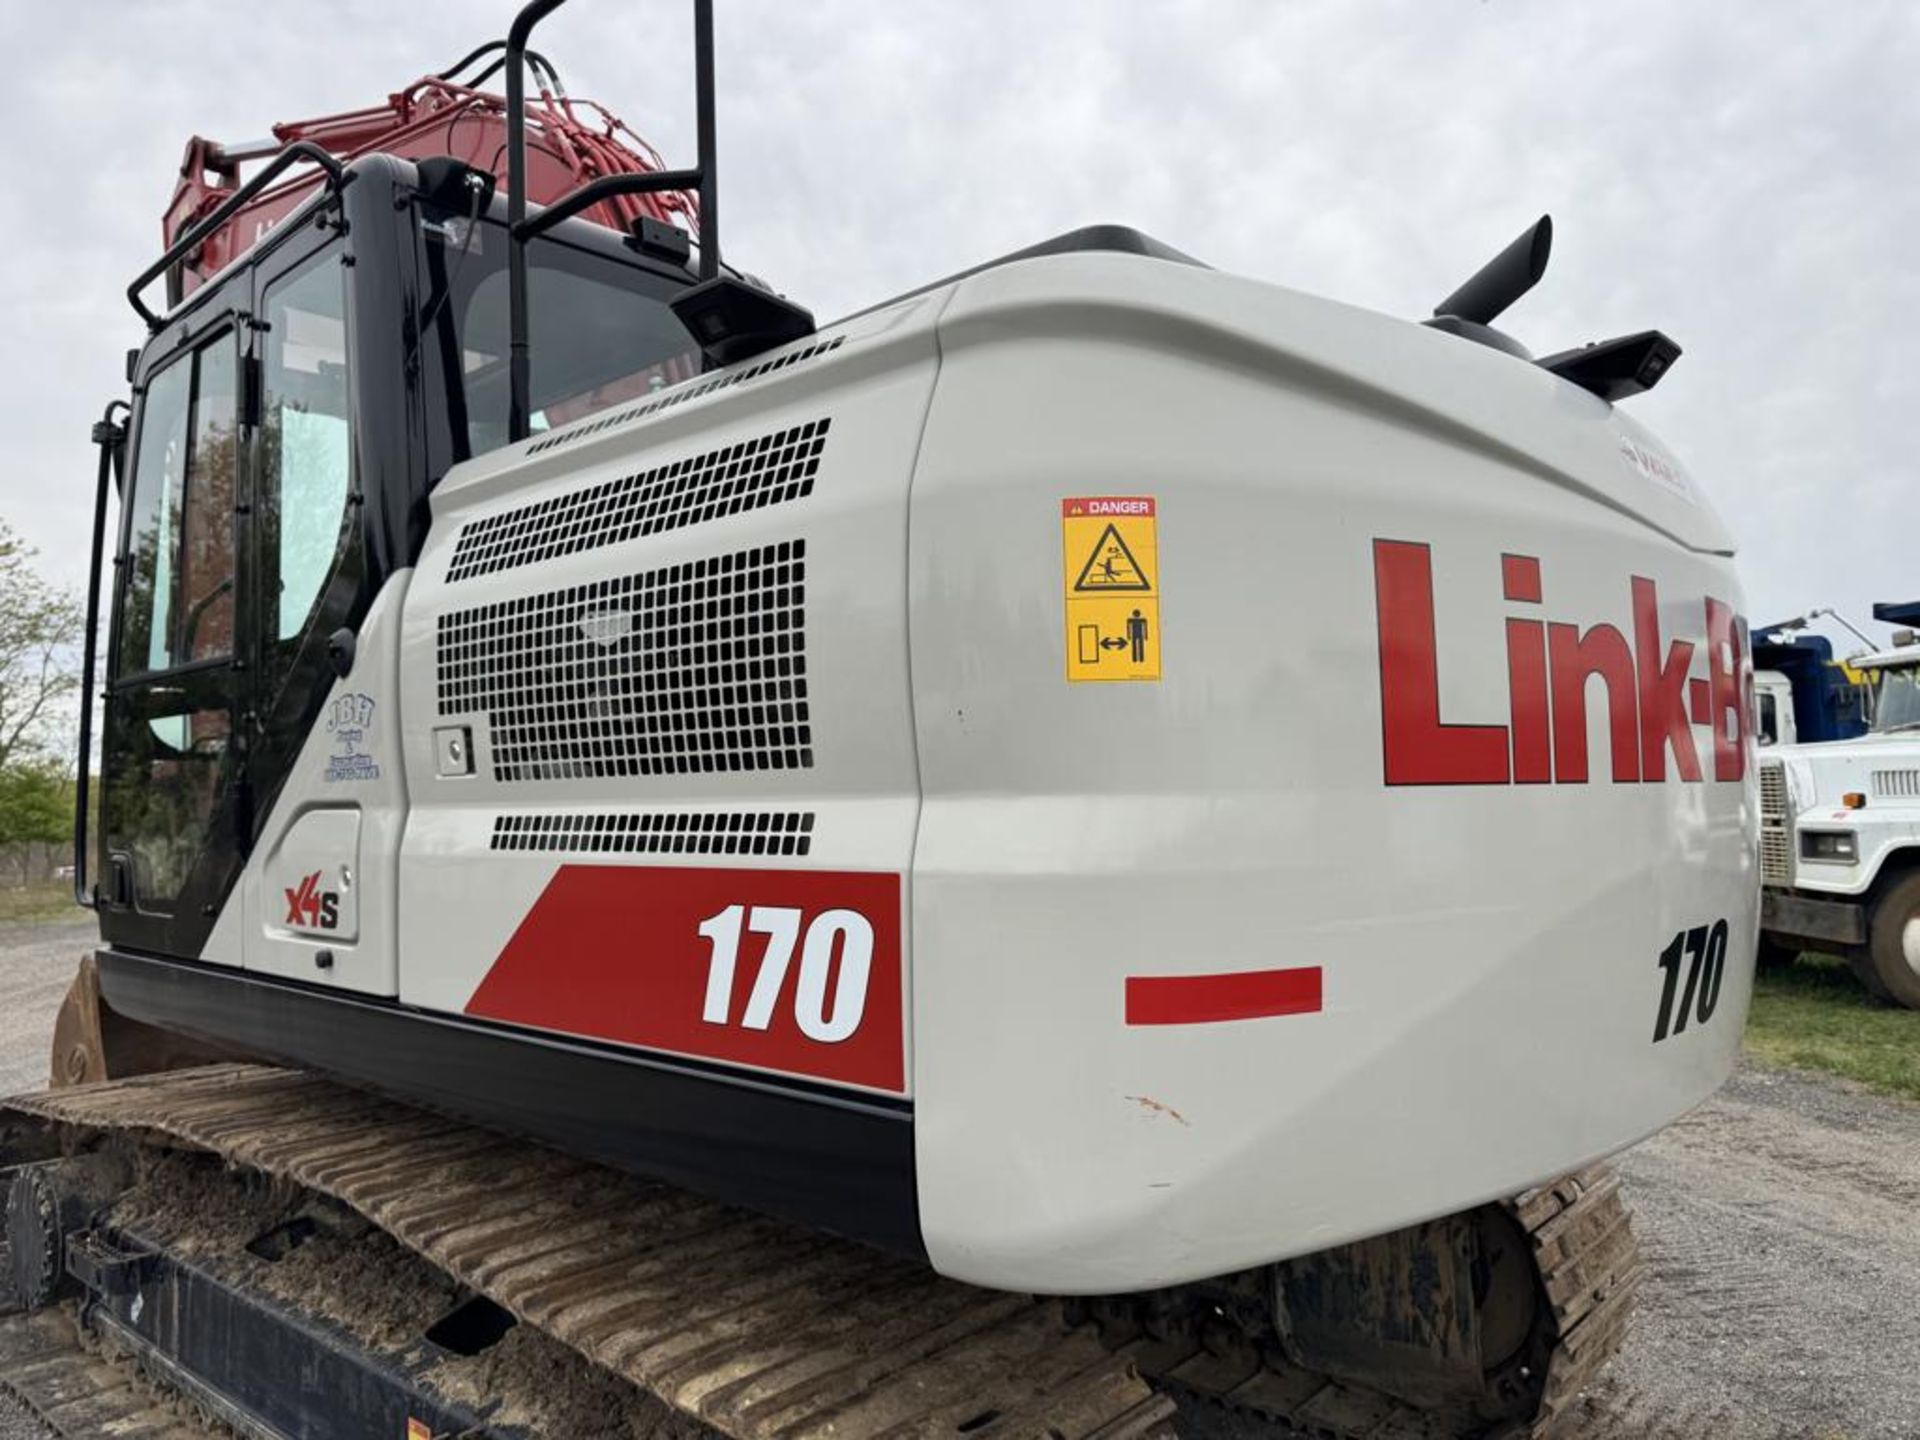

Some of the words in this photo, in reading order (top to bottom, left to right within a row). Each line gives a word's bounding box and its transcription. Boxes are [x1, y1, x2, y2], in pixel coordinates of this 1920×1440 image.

[1088, 501, 1150, 514] DANGER
[326, 692, 376, 732] JBH
[284, 869, 339, 930] X4S
[697, 904, 875, 1044] 170
[1652, 918, 1730, 1043] 170
